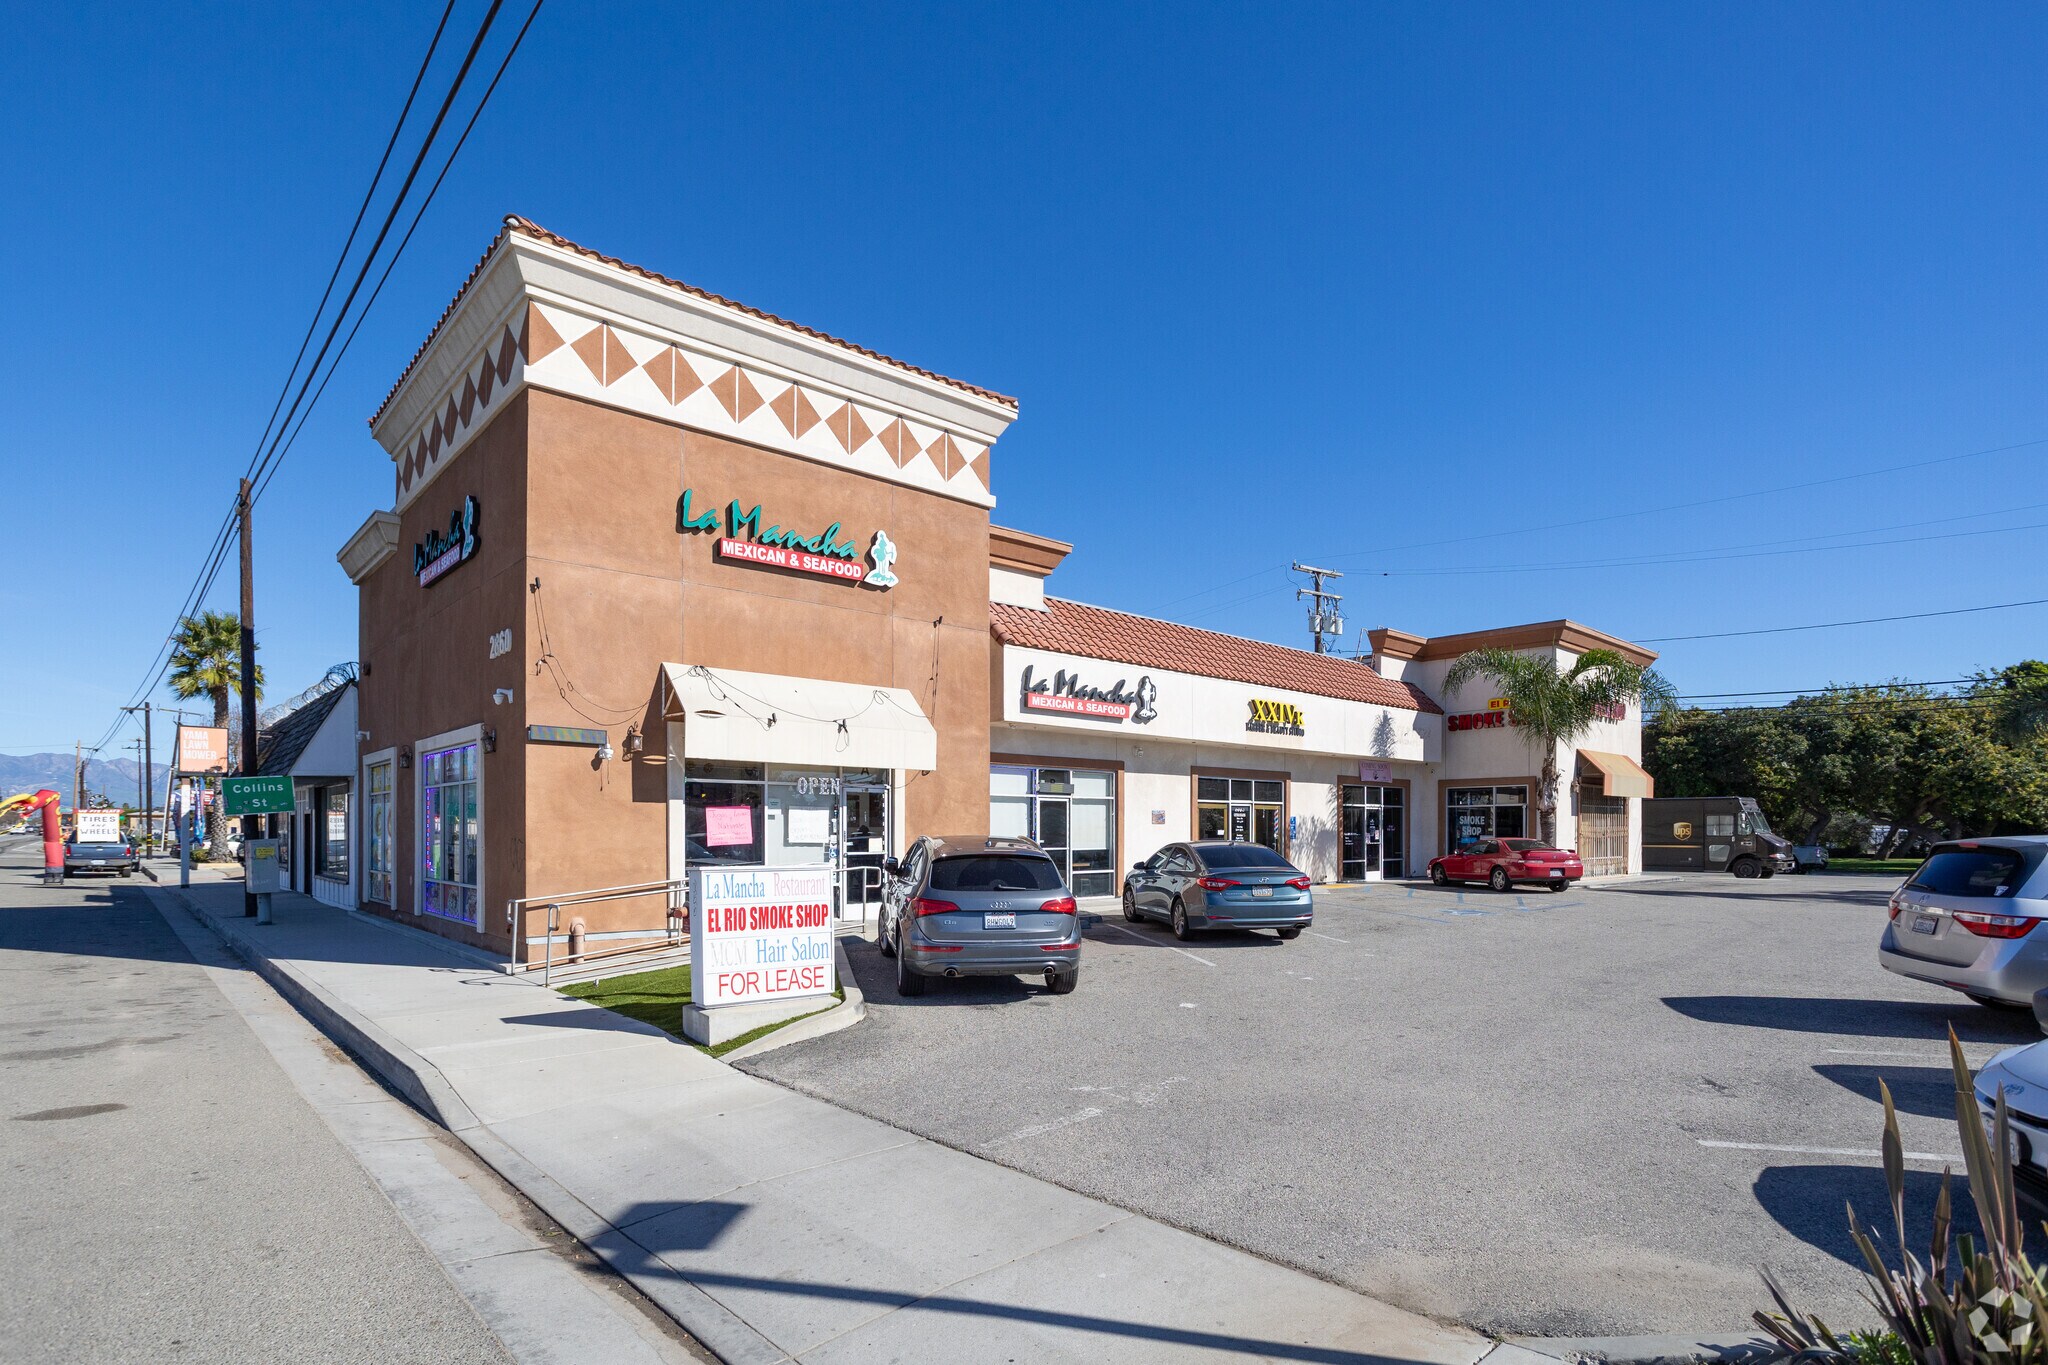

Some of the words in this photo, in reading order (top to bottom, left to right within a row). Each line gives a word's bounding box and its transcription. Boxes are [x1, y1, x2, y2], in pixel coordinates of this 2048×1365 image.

[682, 488, 722, 529] La
[732, 499, 859, 558] Mancha
[441, 547, 460, 570] SEAFOOD
[722, 540, 786, 565] MEXICAN
[789, 552, 800, 567] &
[803, 556, 862, 579] SEAFOOD
[489, 628, 512, 660] 2860
[1021, 664, 1050, 692] La
[1054, 669, 1136, 705] Mancha
[1031, 696, 1075, 710] MEXICAN
[1077, 702, 1084, 711] &
[1086, 703, 1126, 716] SEAFOOD
[1447, 711, 1505, 732] SMOKE
[183, 730, 208, 740] YAMA
[183, 740, 209, 750] LAWN
[183, 750, 217, 760] MOWER
[232, 783, 284, 794] Collins
[798, 776, 841, 796] OPEN
[252, 798, 268, 807] St
[1459, 815, 1485, 825] SMOKE
[1462, 826, 1481, 835] SHOP
[1675, 827, 1690, 838] ups
[706, 874, 720, 899] La
[723, 873, 765, 899] Mancha
[773, 872, 827, 897] Restaurant
[707, 908, 721, 933] EL
[724, 907, 747, 932] RIO
[750, 905, 793, 931] SMOKE
[796, 904, 829, 928] SHOP
[710, 940, 747, 967] MCM
[756, 939, 788, 964] Hair
[791, 936, 830, 962] Salon
[718, 971, 760, 997] FOR
[765, 966, 825, 993] LEASE
